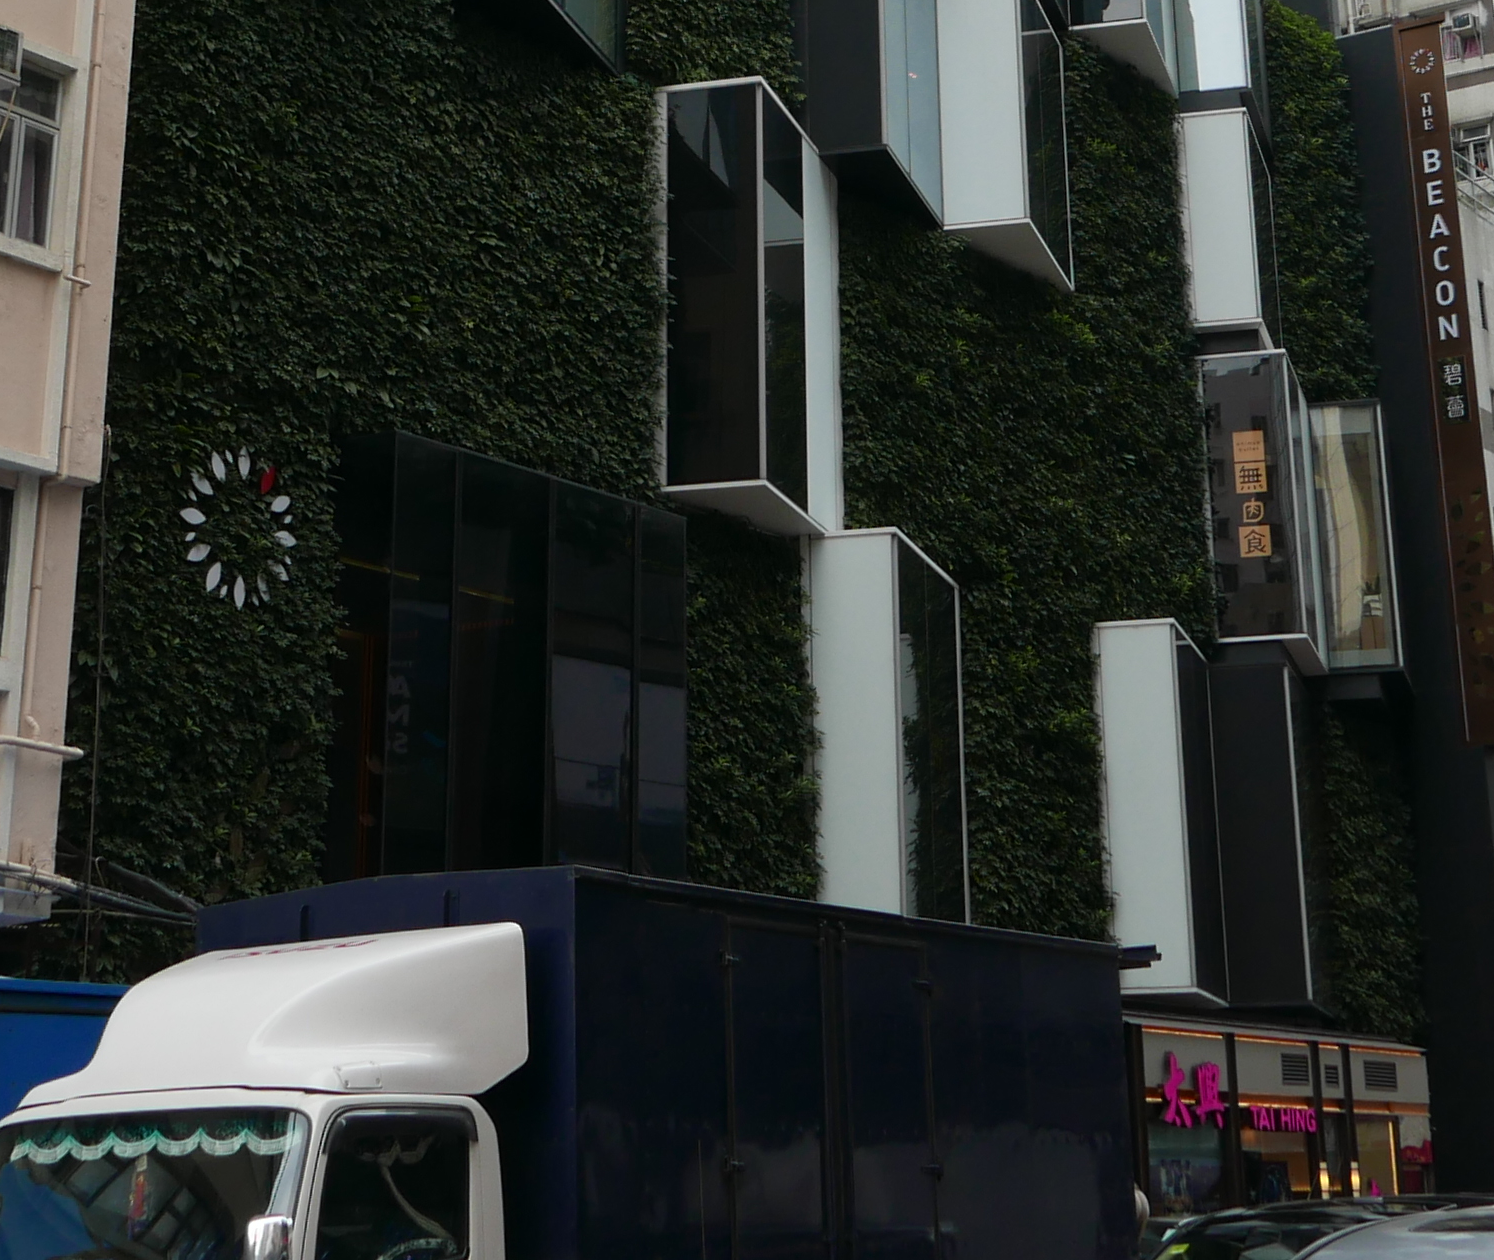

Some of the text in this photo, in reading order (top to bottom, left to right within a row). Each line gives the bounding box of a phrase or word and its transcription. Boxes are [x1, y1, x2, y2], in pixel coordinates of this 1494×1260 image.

[1419, 91, 1460, 341] THE BEACON
[1238, 464, 1267, 555] 無肉食
[1163, 1051, 1225, 1129] 太興
[1250, 1106, 1317, 1133] TAI HING
